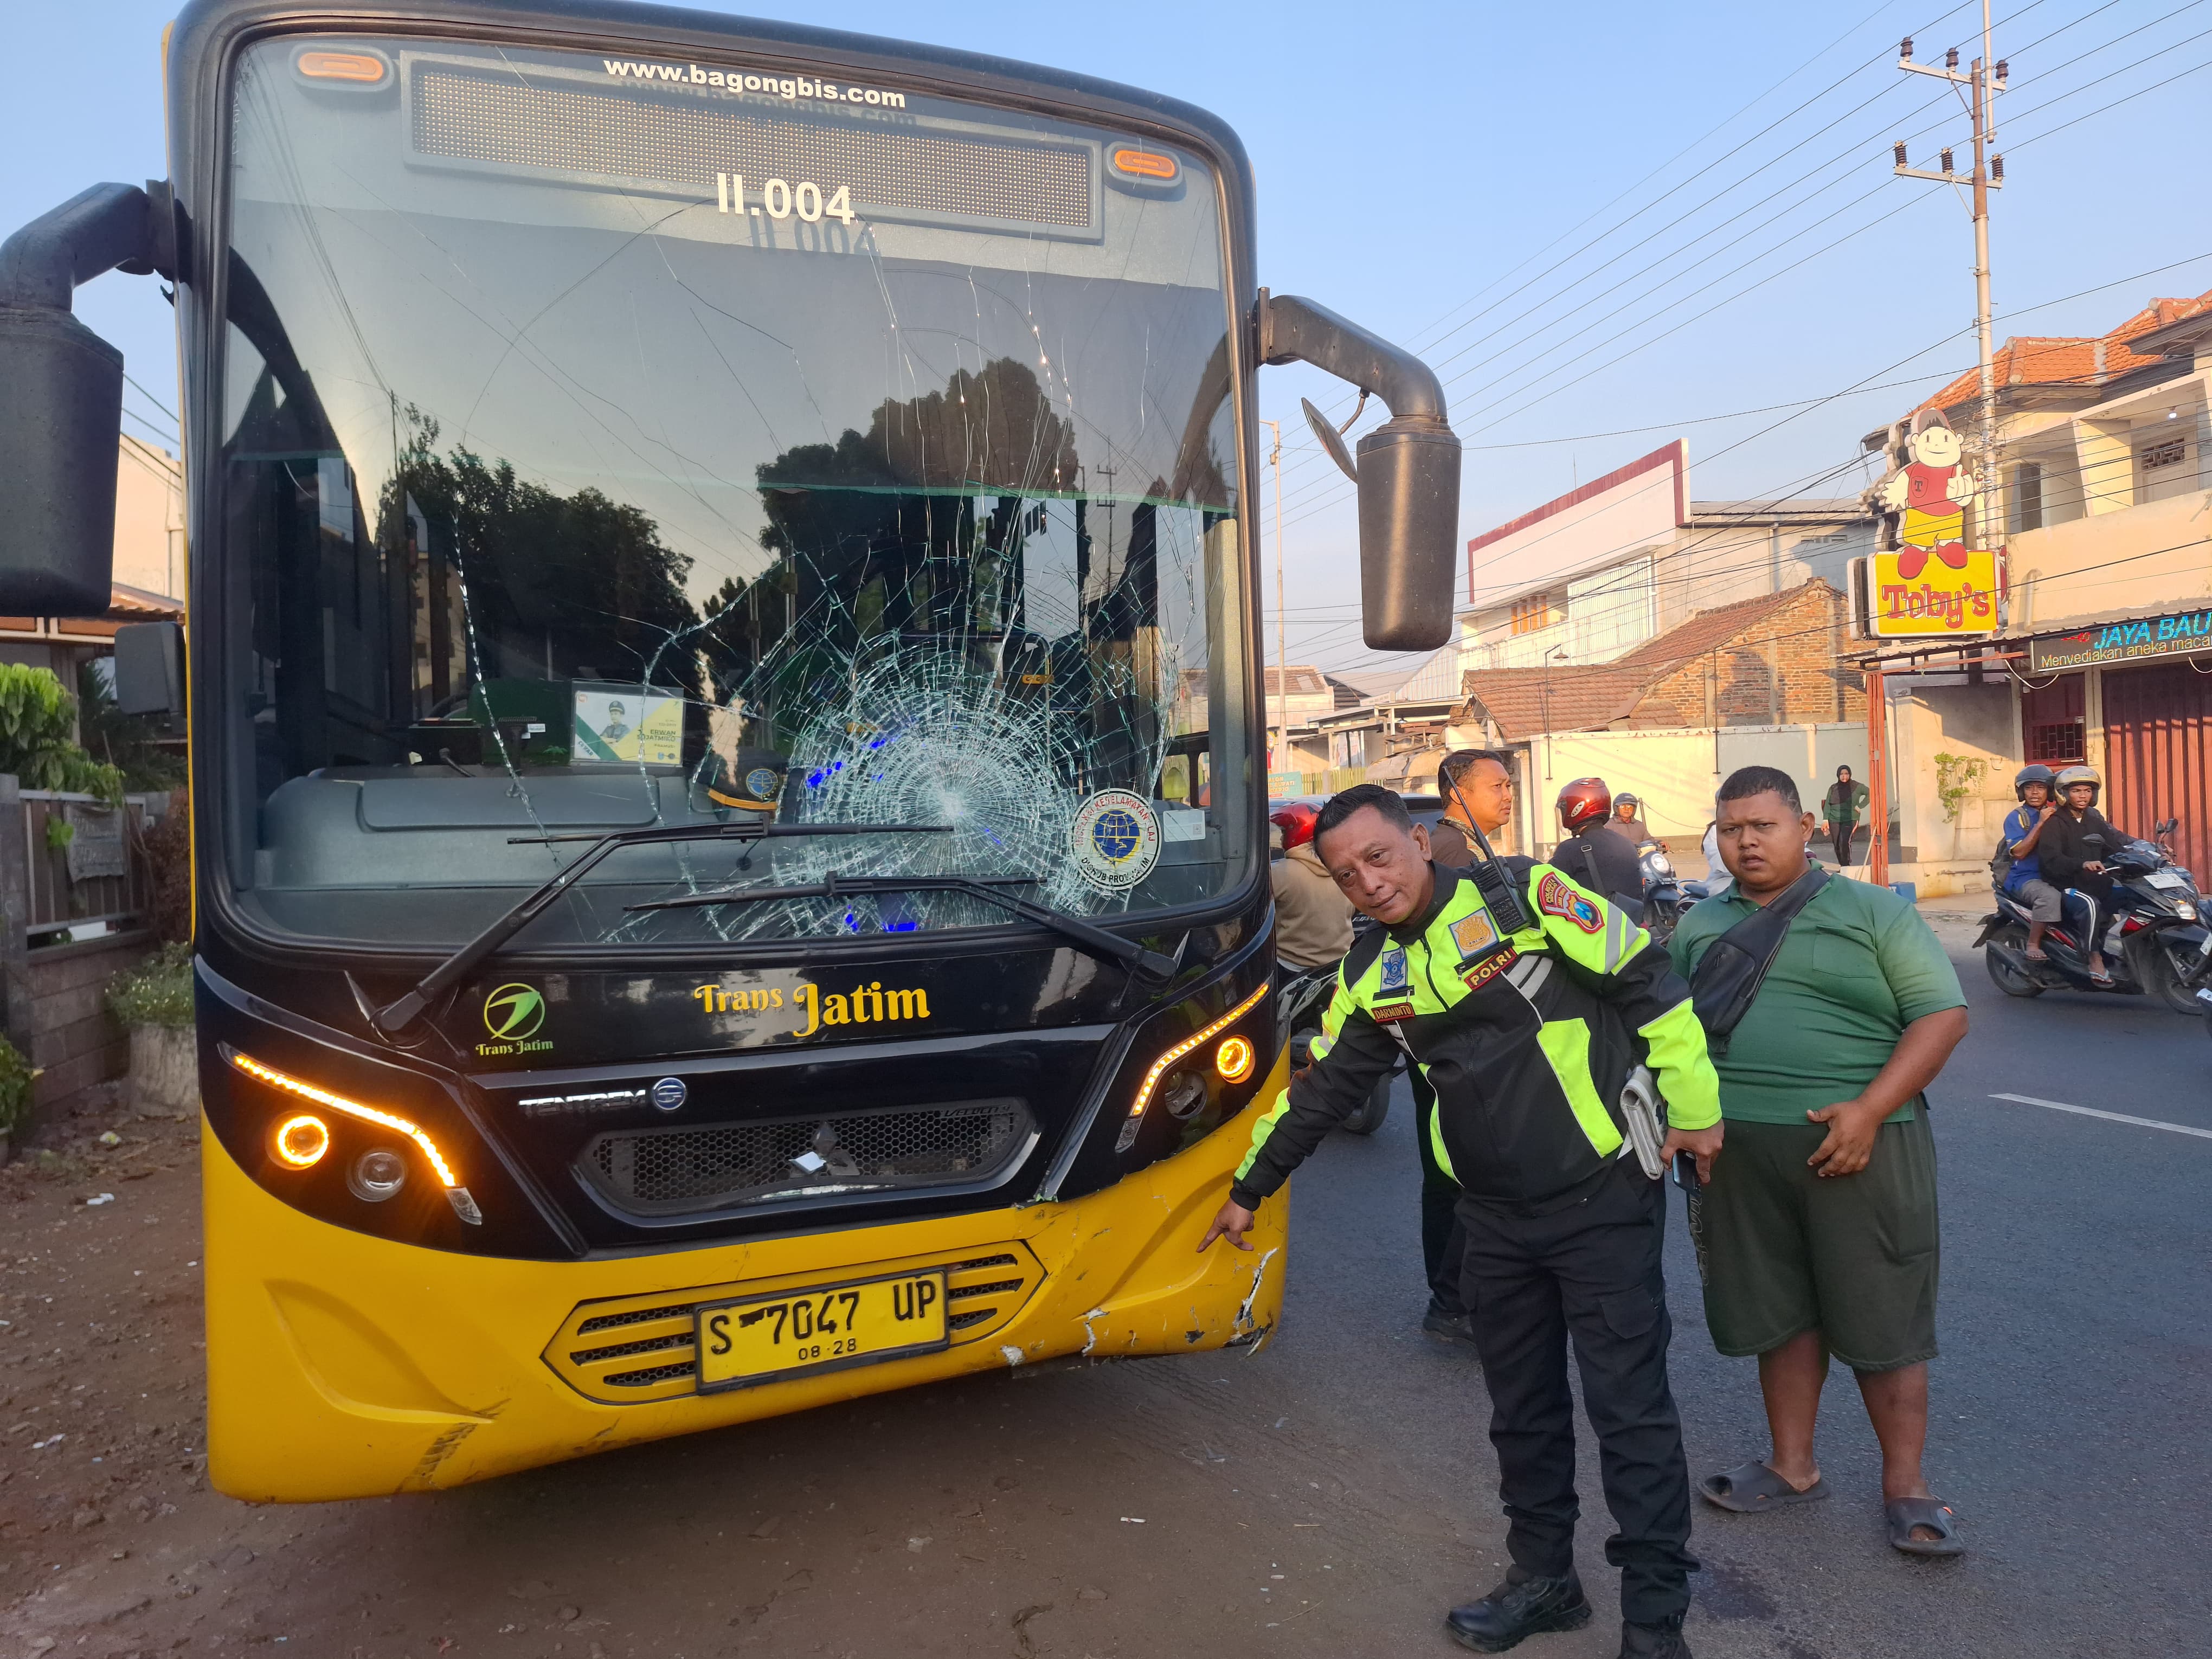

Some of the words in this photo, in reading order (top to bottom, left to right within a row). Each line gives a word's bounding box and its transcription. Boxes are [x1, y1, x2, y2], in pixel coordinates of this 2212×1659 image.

[603, 59, 906, 108] www.bagongbis.com
[716, 171, 856, 225] II.004
[1914, 480, 1923, 492] T
[1881, 582, 1990, 629] Toby's
[2041, 647, 2123, 668] Menyediakan
[2127, 641, 2168, 657] aneka
[2171, 635, 2212, 652] maca
[2094, 621, 2151, 650] JAYA
[1470, 950, 1512, 986] POLRI
[693, 982, 784, 1013] Trans
[793, 981, 931, 1038] Jatim
[1374, 1005, 1412, 1020] DARMINTO
[475, 1042, 515, 1057] Trans
[515, 1037, 554, 1055] Jatim
[518, 1089, 646, 1116] TENTREM
[767, 1290, 861, 1345] 7047
[893, 1279, 937, 1322] UP
